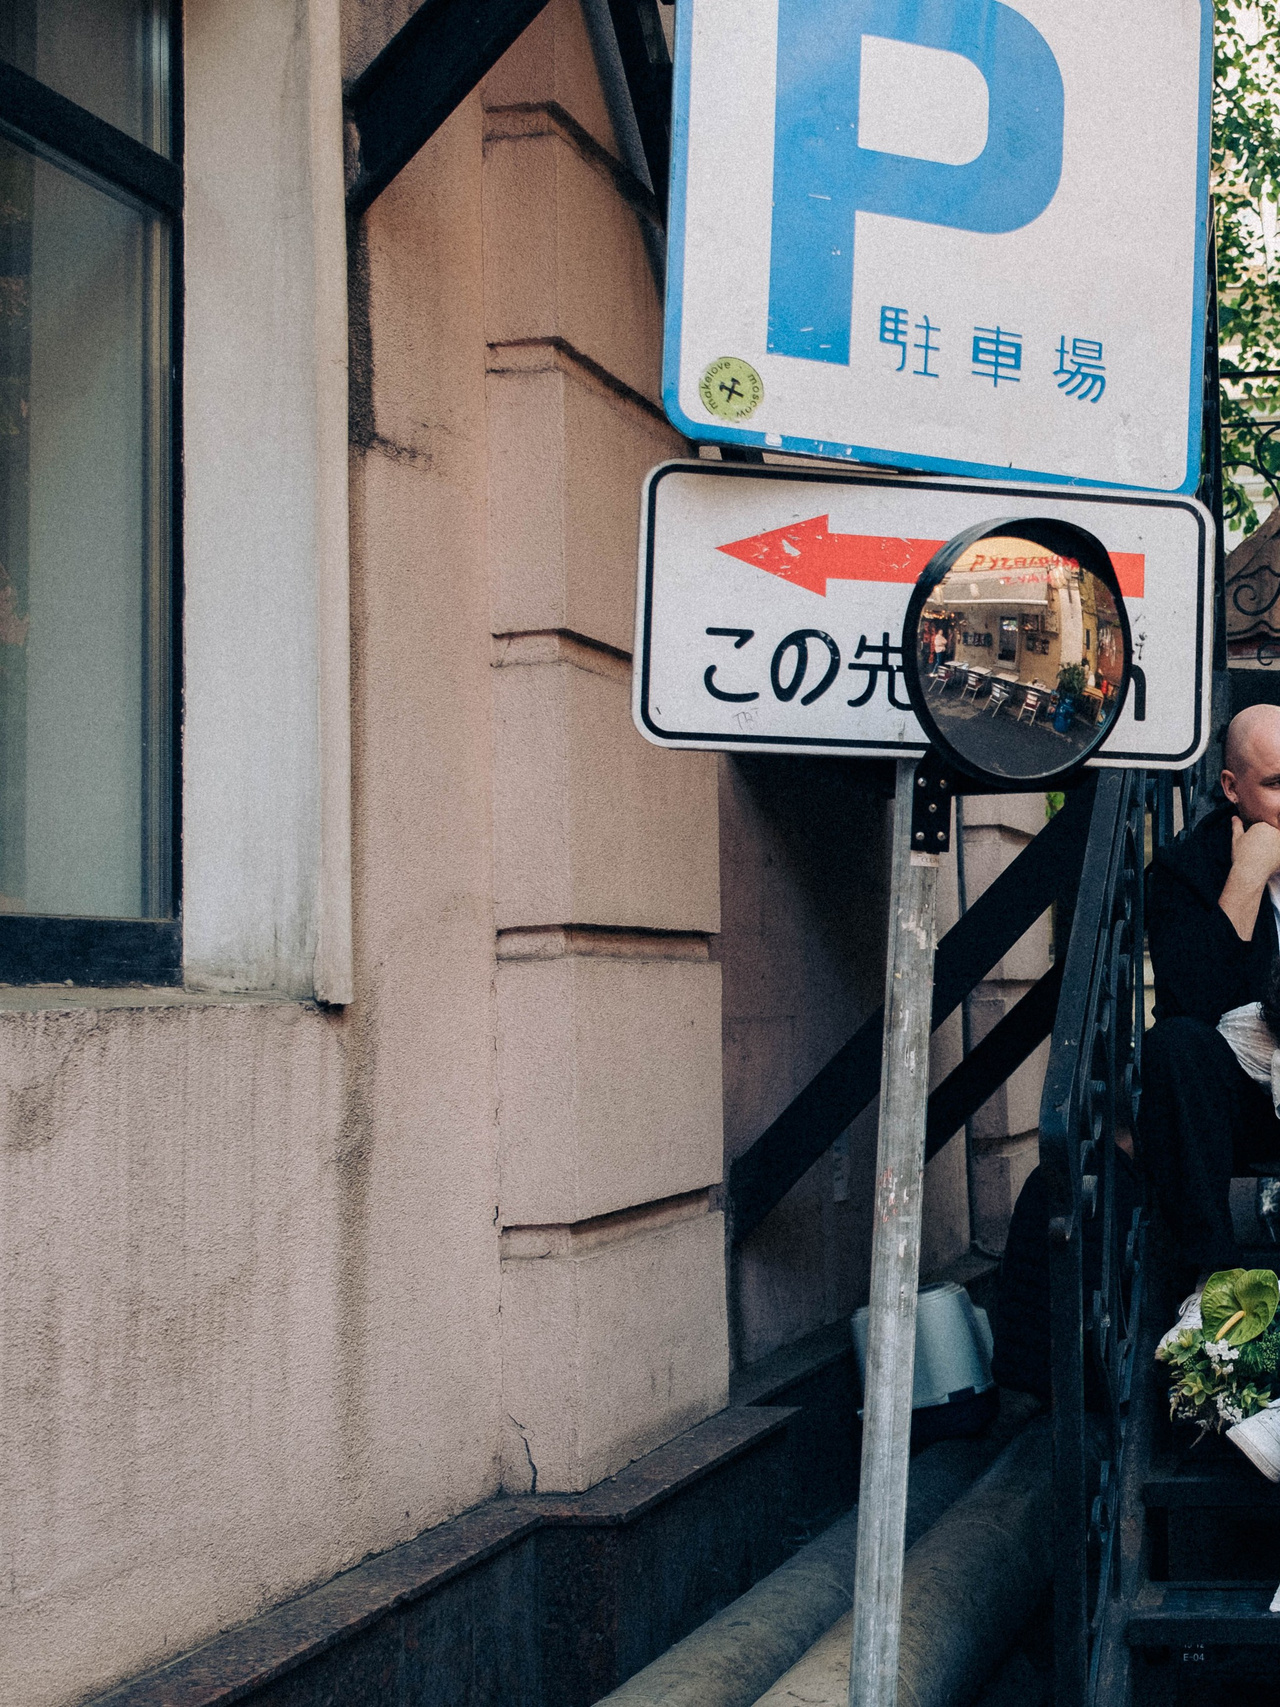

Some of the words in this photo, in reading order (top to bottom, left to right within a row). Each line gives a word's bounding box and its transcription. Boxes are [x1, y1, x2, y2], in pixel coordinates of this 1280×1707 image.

[767, 0, 1065, 366] P
[701, 361, 731, 410] makelove
[736, 374, 760, 417] moscow
[879, 305, 1107, 403] 駐車場
